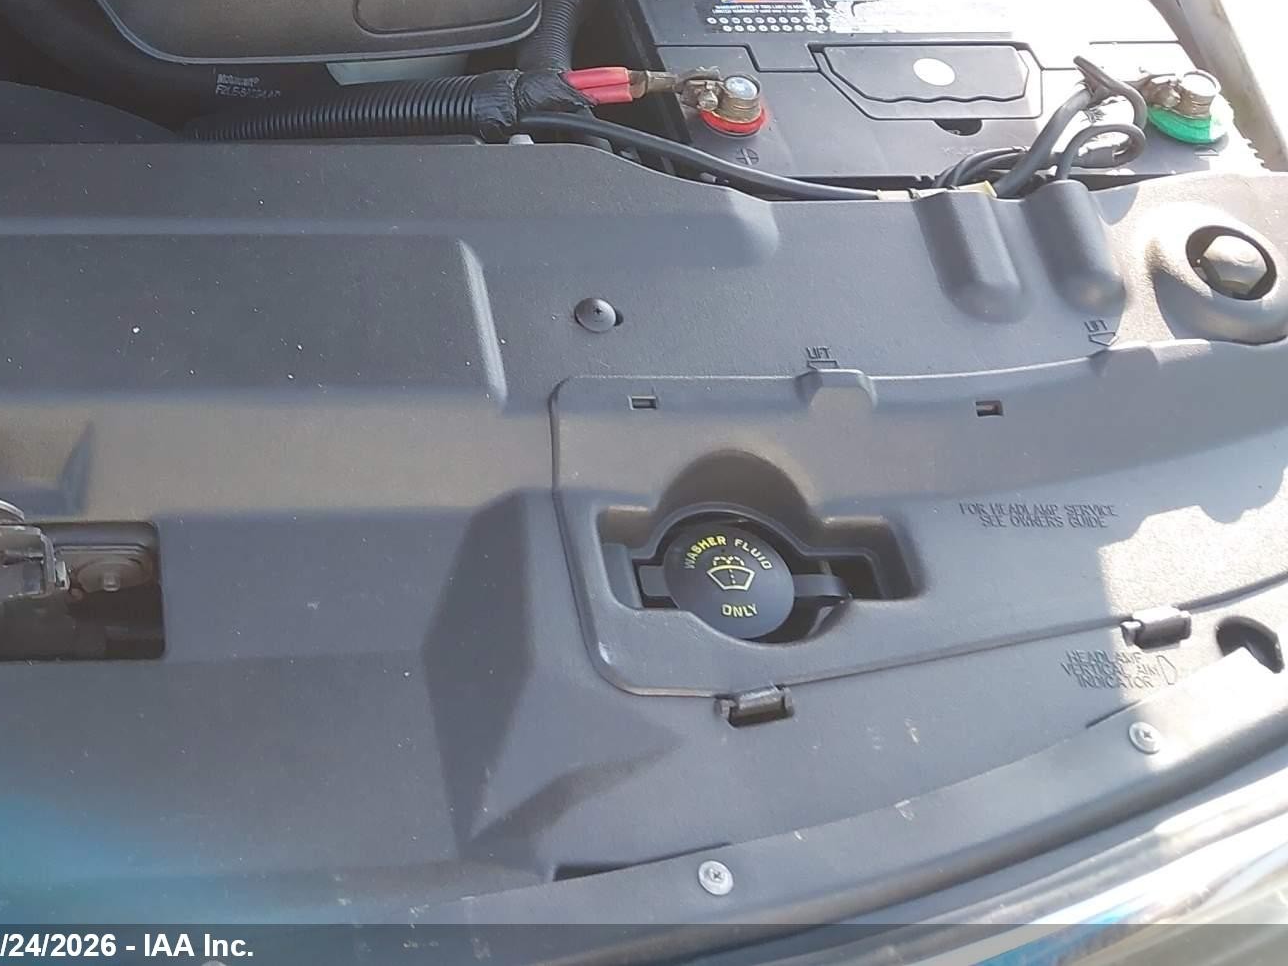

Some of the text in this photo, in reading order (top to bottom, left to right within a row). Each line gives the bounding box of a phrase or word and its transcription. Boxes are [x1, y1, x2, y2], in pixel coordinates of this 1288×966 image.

[1083, 319, 1108, 332] LIFT
[806, 346, 831, 359] LIFT
[959, 502, 1118, 516] FOR HEADLAMP SERVICE
[979, 515, 1109, 528] SEE OWNERS GUIDE
[683, 535, 773, 570] WASHER FLUID
[722, 603, 758, 618] ONLY
[1064, 650, 1143, 663] HEADLAMP
[1078, 675, 1154, 689] INDICATOR
